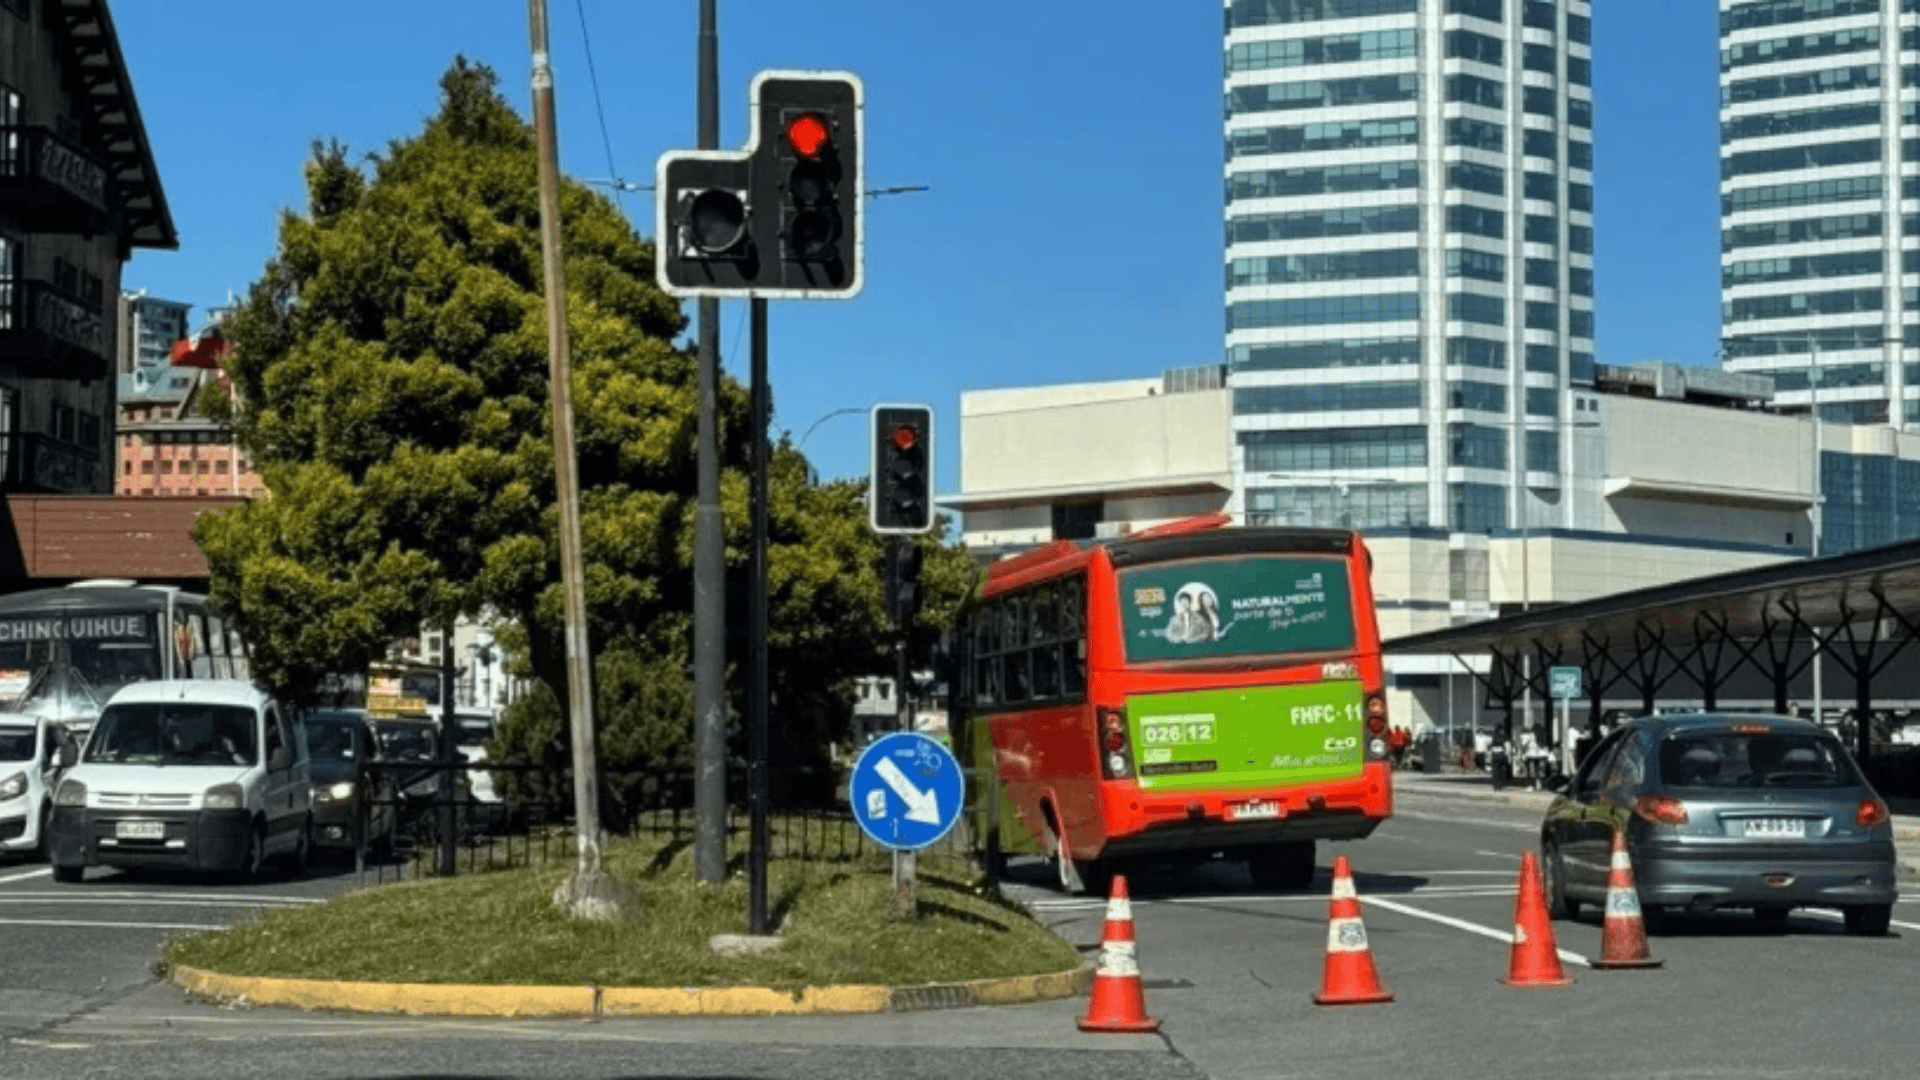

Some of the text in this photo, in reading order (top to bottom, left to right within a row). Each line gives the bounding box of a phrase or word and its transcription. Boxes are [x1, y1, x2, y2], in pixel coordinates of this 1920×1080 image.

[1232, 592, 1325, 609] NATURALMENTE
[1145, 724, 1213, 744] 026 12
